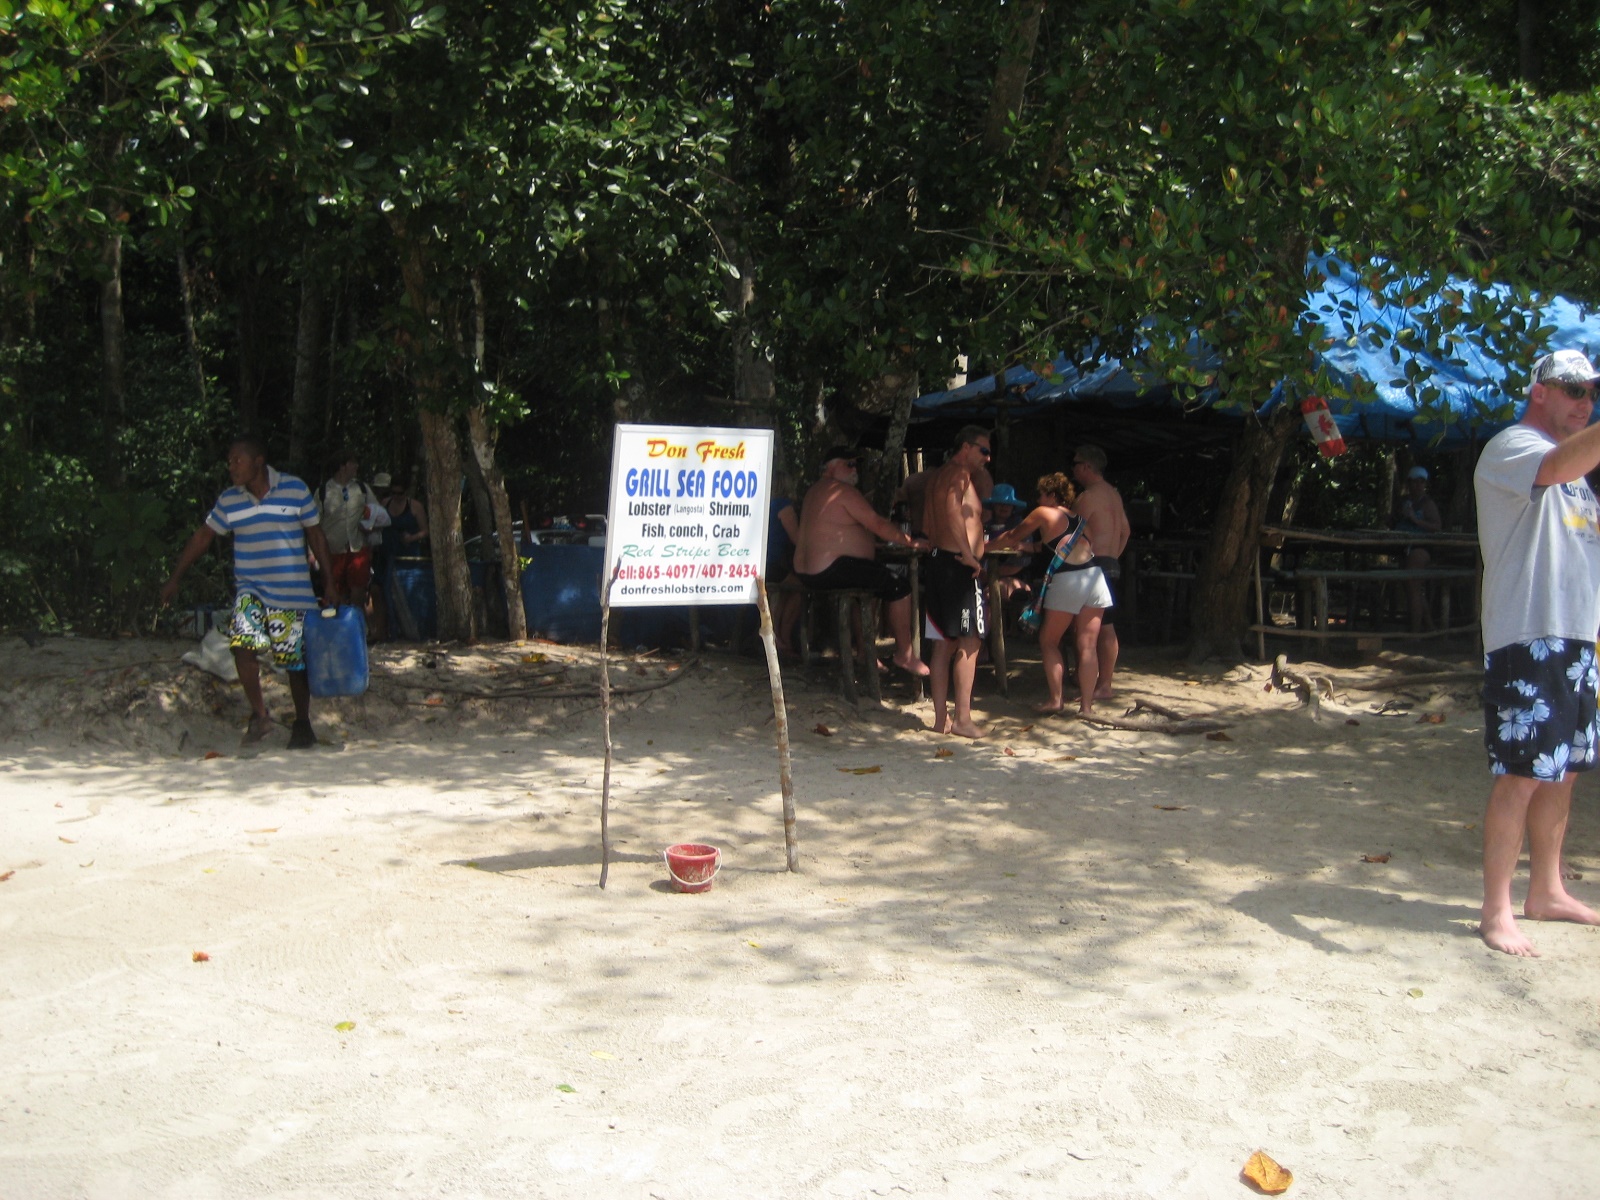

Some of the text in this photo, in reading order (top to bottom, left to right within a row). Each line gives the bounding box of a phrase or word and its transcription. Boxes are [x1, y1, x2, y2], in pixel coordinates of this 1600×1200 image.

[646, 439, 746, 463] Don Fresh
[625, 467, 758, 499] GRILL SEA FOOD
[628, 501, 672, 516] Lobster
[709, 501, 752, 518] Shrimp,
[641, 523, 741, 541] Fish, conch, Crab
[622, 543, 751, 560] Red Stripe Beer
[620, 584, 744, 596] donfreshlobsters.com
